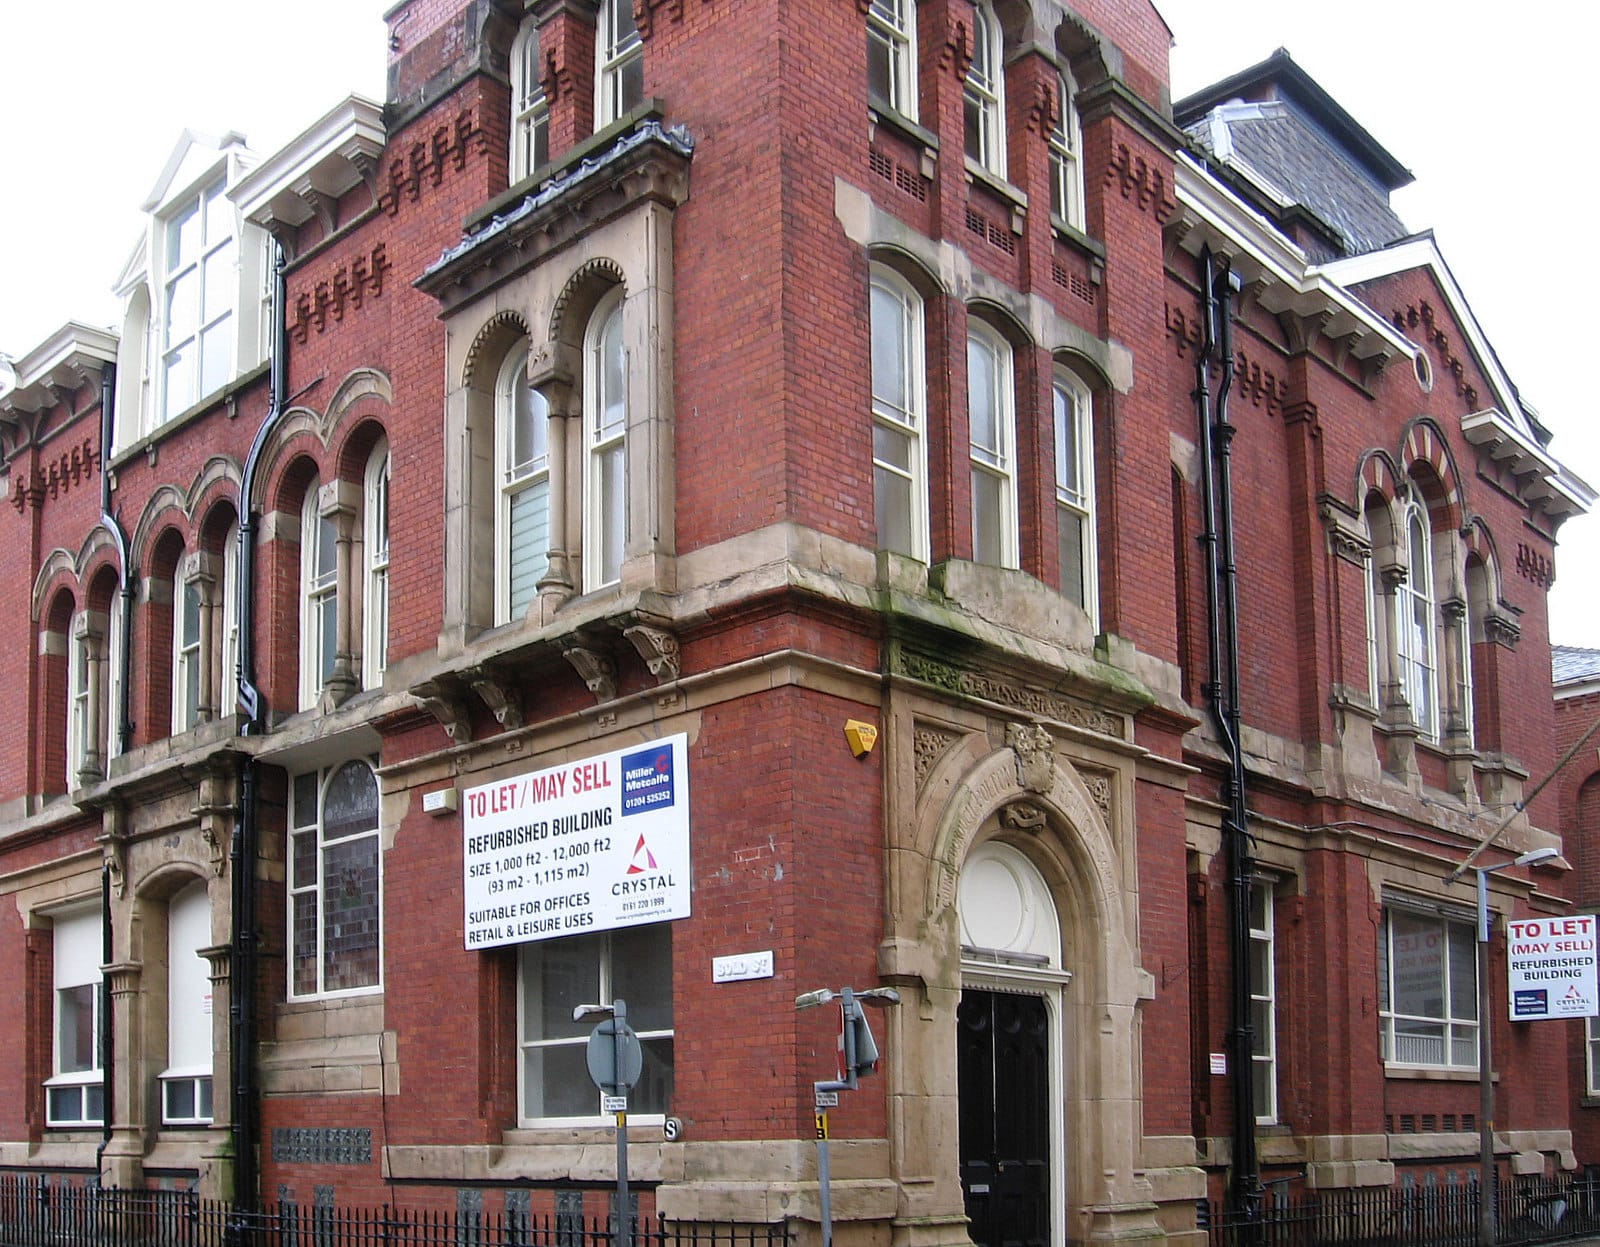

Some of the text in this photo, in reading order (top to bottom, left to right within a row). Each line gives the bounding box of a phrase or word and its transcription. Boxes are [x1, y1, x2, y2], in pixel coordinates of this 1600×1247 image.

[625, 767, 655, 781] Miller
[468, 791, 487, 819] TO
[491, 784, 518, 814] LET
[532, 770, 567, 804] MAY
[572, 760, 612, 795] SELL
[625, 796, 646, 809] 01204
[468, 806, 612, 855] REFURBISHED BUILDING
[469, 862, 491, 878] SIZE
[495, 855, 523, 874] 1,000
[526, 852, 542, 867] ft2
[553, 841, 590, 861] 12,000
[594, 837, 612, 853] ft2
[488, 879, 504, 896] (93
[507, 875, 524, 891] m2
[535, 867, 563, 886] 1,115
[567, 861, 590, 880] m2)
[611, 873, 676, 896] CRYSTAL
[468, 891, 591, 925] SUITABLE FOR OFFICES
[468, 911, 594, 944] RETAIL & LEISURE USES
[1510, 919, 1592, 939] TO LET
[1511, 939, 1593, 955] (MAY SELL)
[1512, 957, 1593, 971] REFURBISHED
[1524, 969, 1582, 981] BUILDING
[1556, 998, 1591, 1006] CRYSTAL
[665, 1120, 676, 1139] S
